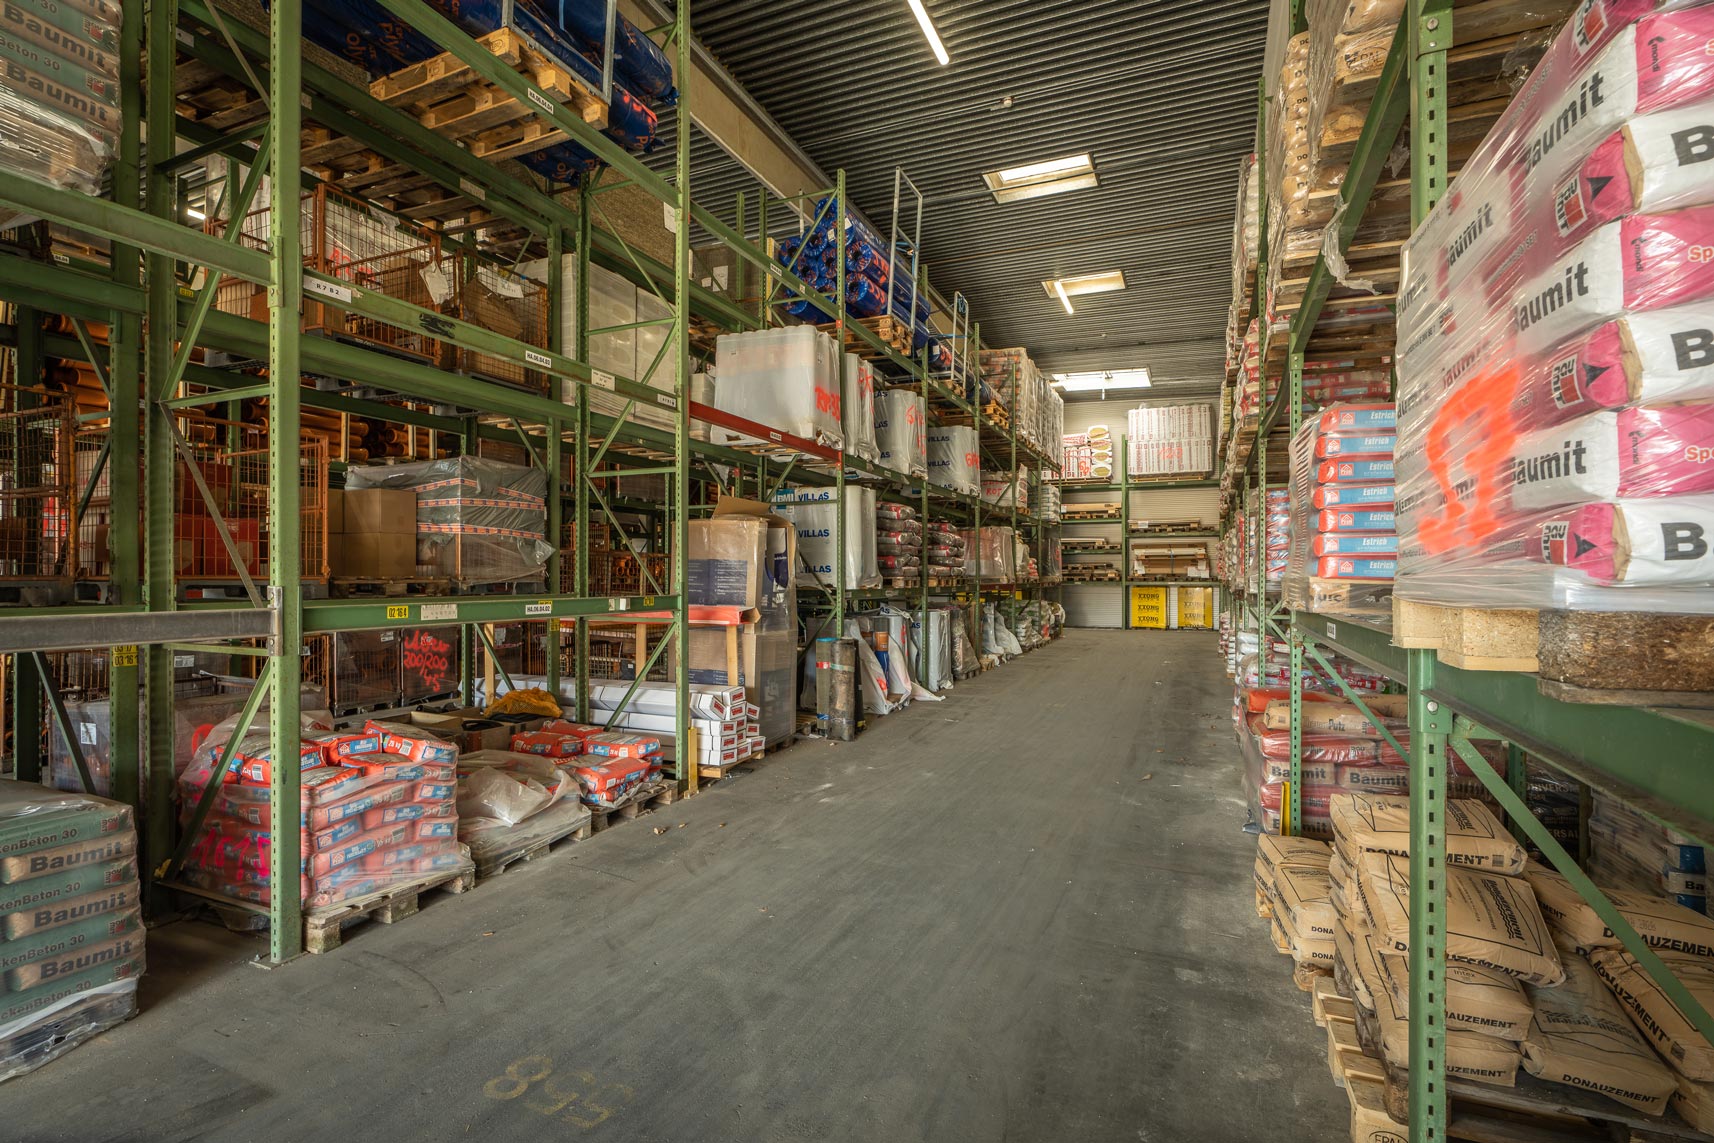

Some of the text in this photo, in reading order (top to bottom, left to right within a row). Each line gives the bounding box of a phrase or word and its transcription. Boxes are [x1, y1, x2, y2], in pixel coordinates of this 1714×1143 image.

[4, 2, 107, 69] Baumit
[43, 57, 60, 71] 30
[7, 62, 108, 121] Baumit
[798, 492, 829, 501] VILLAS
[798, 529, 830, 538] VILLAS
[1350, 772, 1409, 787] Baumit
[61, 828, 78, 840] 30
[30, 840, 124, 873] Baumit
[65, 881, 81, 892] 30
[34, 890, 128, 929] Baumit
[69, 933, 86, 945] 30
[40, 939, 133, 980] Baumit
[76, 980, 92, 992] 30
[1562, 1073, 1660, 1104] DONAUZEMENT
